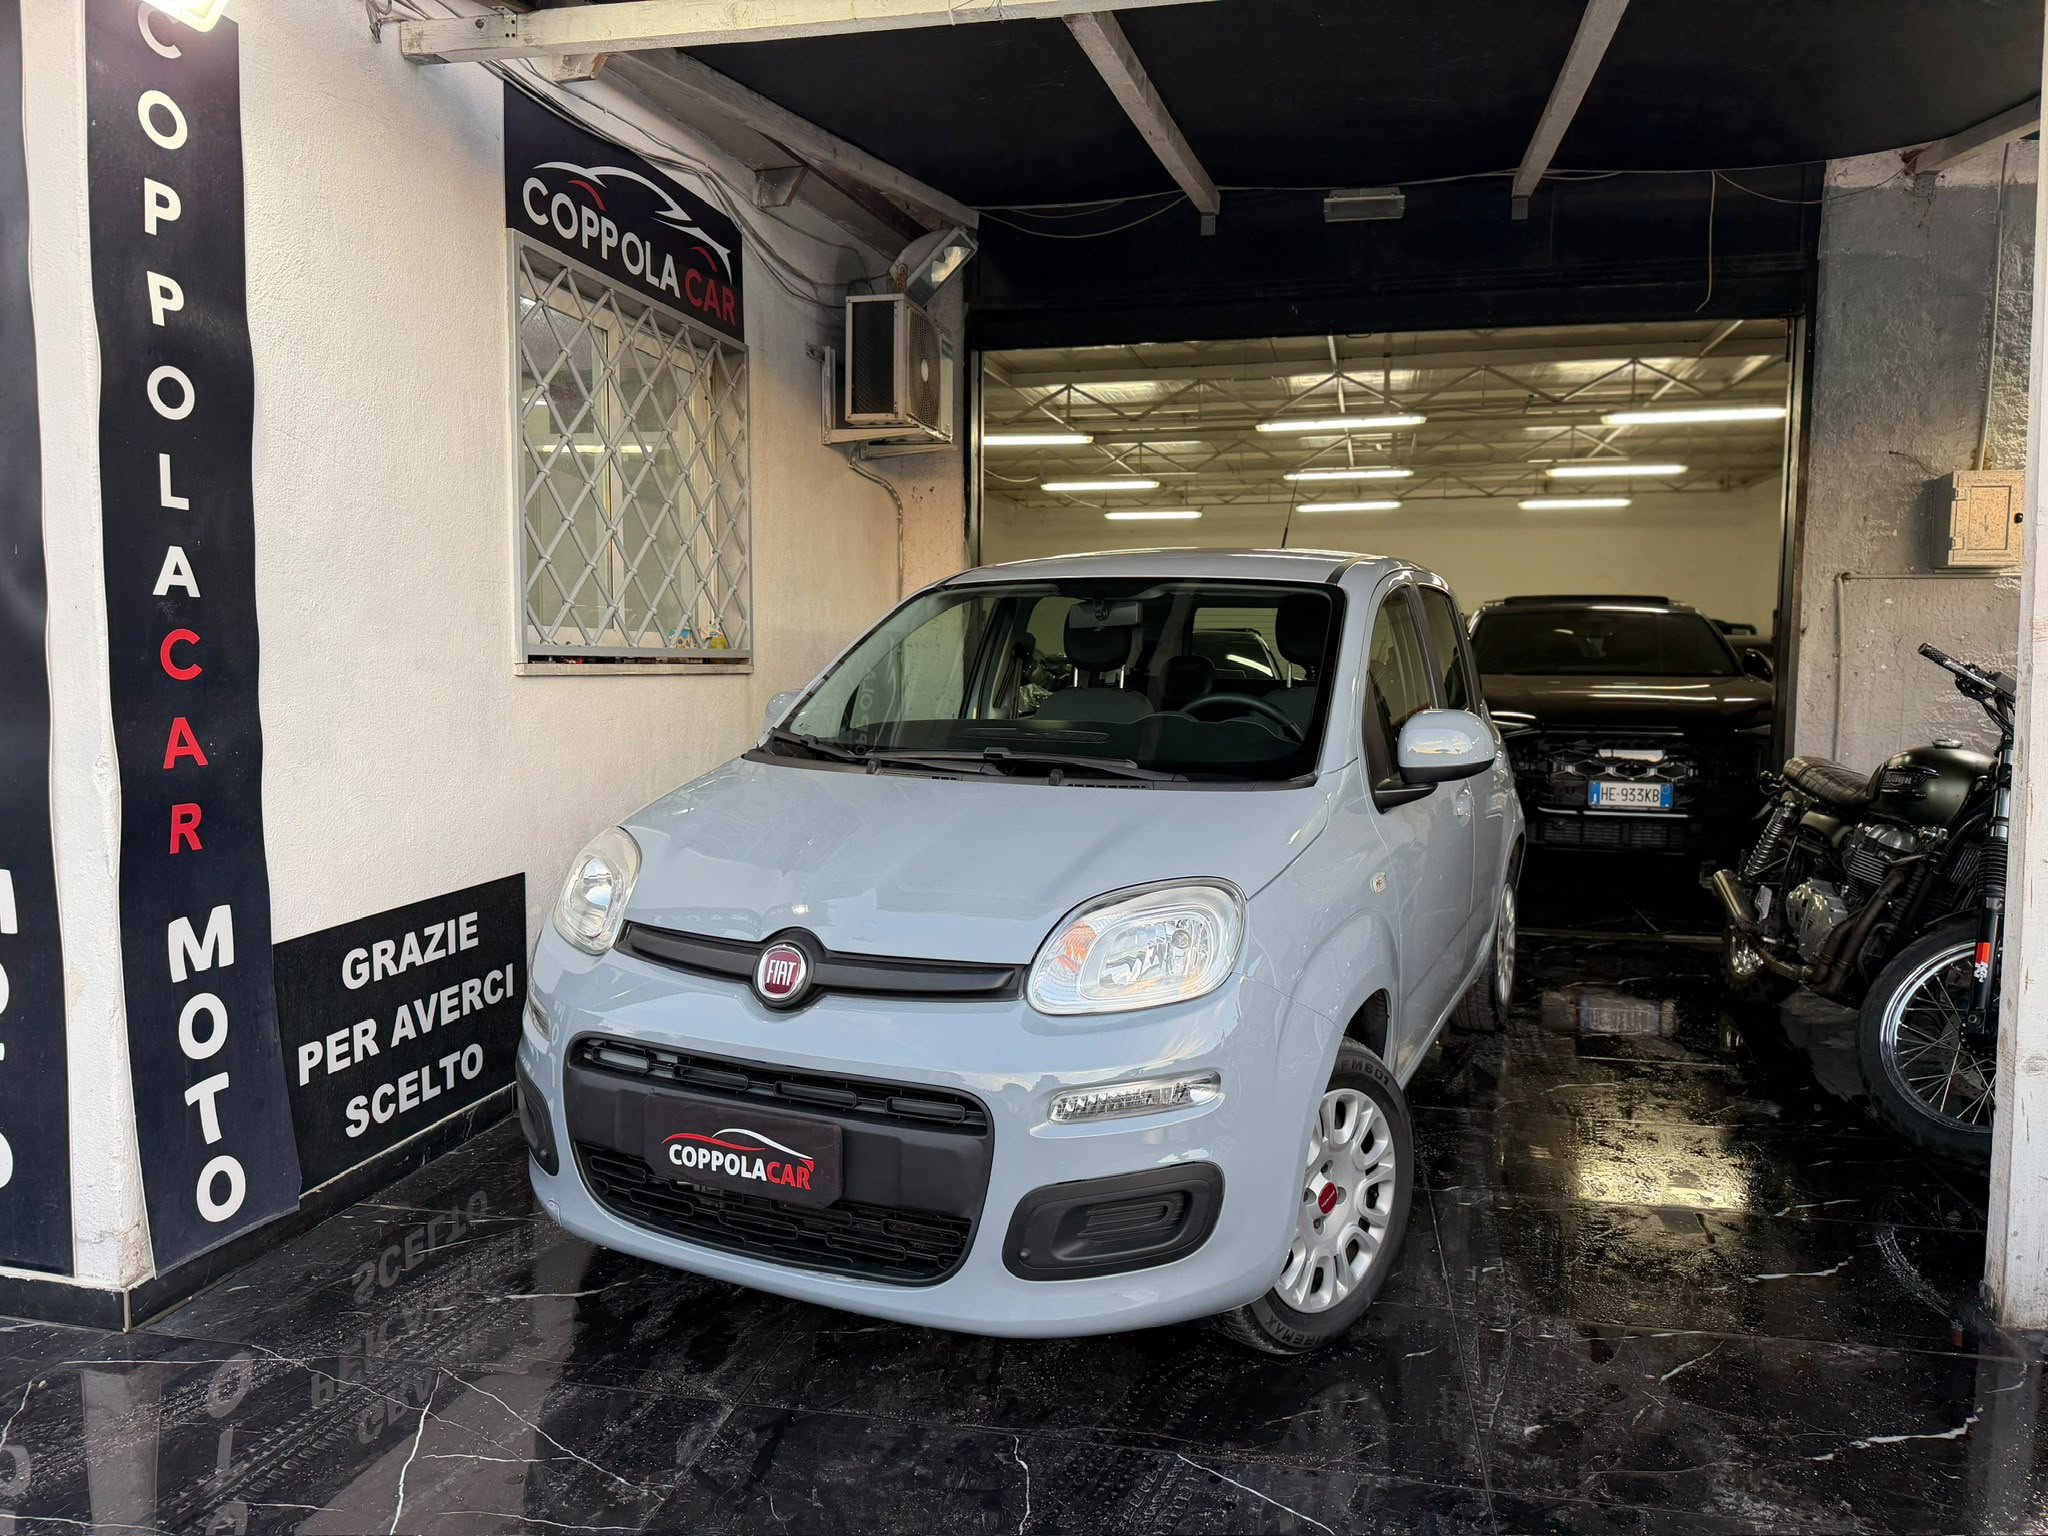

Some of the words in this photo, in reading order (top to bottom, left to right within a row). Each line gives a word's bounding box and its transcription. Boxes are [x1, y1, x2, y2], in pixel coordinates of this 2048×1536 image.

[522, 177, 681, 299] COPPOLA
[685, 268, 736, 326] CAR
[341, 911, 479, 990] GRAZIE
[766, 959, 797, 986] FIAT
[167, 904, 246, 1223] MOTO
[298, 1018, 380, 1087] PER
[390, 963, 514, 1048] AVERCI
[345, 1043, 483, 1138] SCELTO
